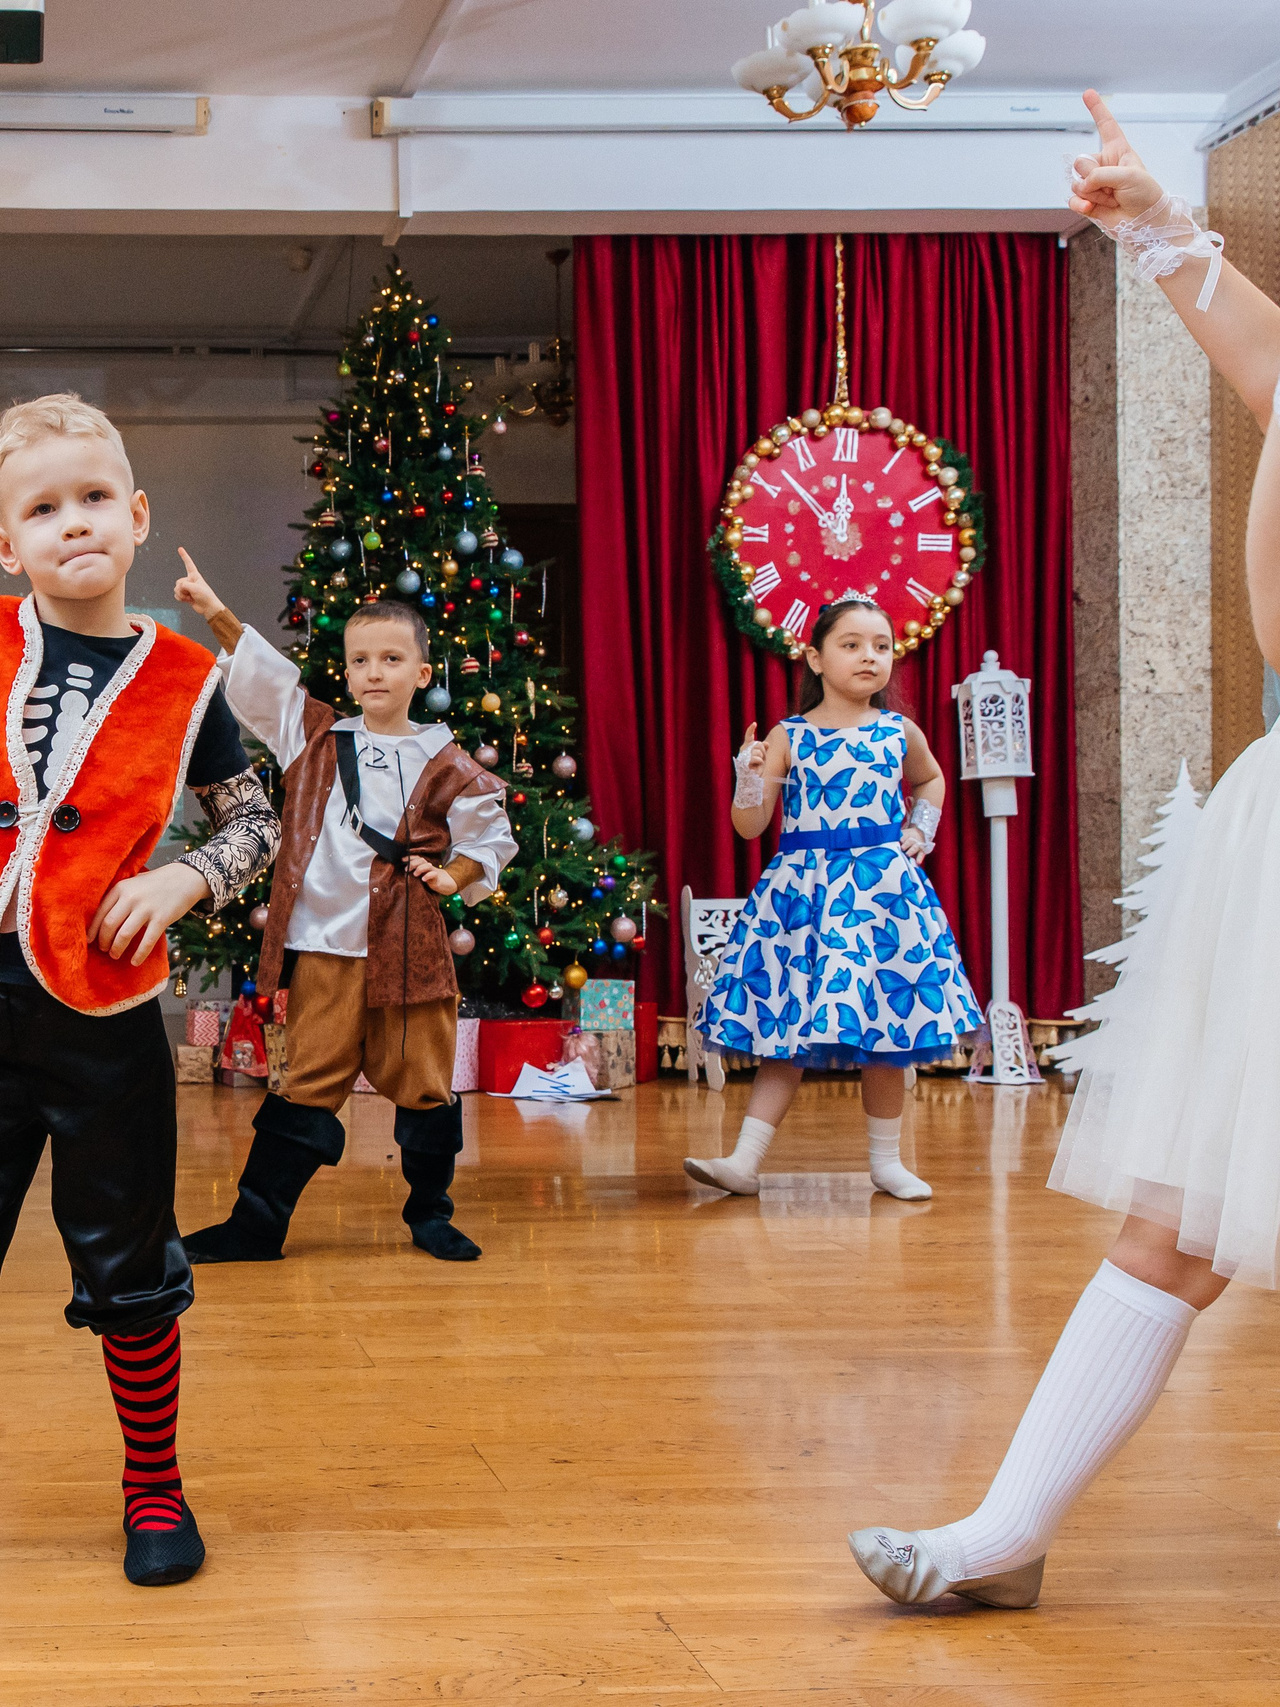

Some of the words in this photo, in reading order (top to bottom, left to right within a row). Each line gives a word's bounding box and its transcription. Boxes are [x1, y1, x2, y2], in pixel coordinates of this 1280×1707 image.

[787, 436, 817, 472] XI
[832, 428, 859, 462] XII
[882, 447, 906, 475] I
[750, 471, 782, 499] X
[908, 486, 943, 513] II
[742, 523, 769, 543] IX
[917, 532, 953, 552] III
[750, 561, 782, 603] VIII
[780, 598, 811, 638] VII
